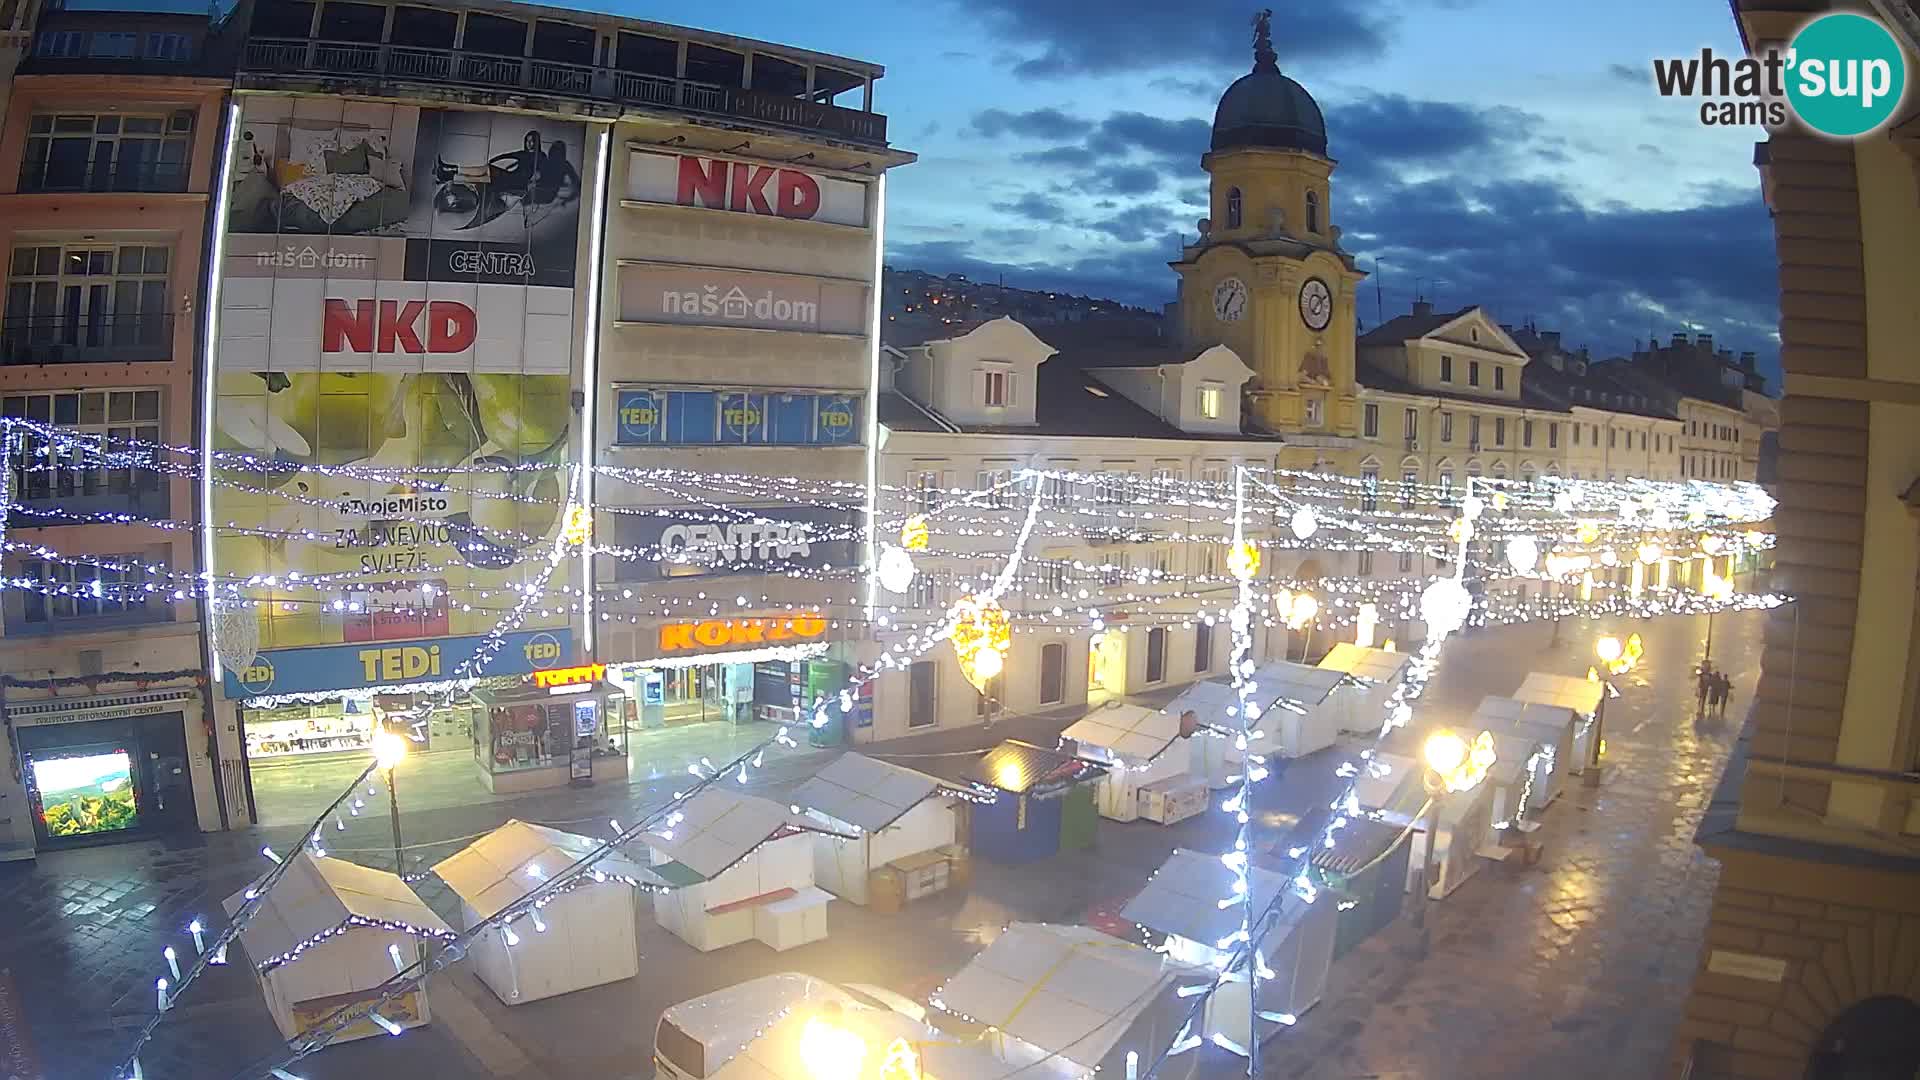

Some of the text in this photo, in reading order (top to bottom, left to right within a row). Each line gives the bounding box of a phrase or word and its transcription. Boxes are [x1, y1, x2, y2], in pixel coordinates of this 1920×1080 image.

[677, 156, 820, 220] NKD
[257, 246, 368, 270] naš dom
[449, 250, 535, 277] CENTRA
[663, 285, 816, 324] naš dom
[322, 298, 477, 354] NKD
[620, 408, 658, 426] TEDi
[724, 408, 761, 426] TEDi
[820, 411, 853, 427] TEDi
[340, 496, 447, 516] #TvojeMisto
[335, 525, 451, 548] ZA DNEVNO
[660, 523, 811, 562] CENTRA
[361, 547, 429, 575] SVJEŽE
[524, 643, 560, 660] TEDi
[360, 646, 440, 683] TEDi
